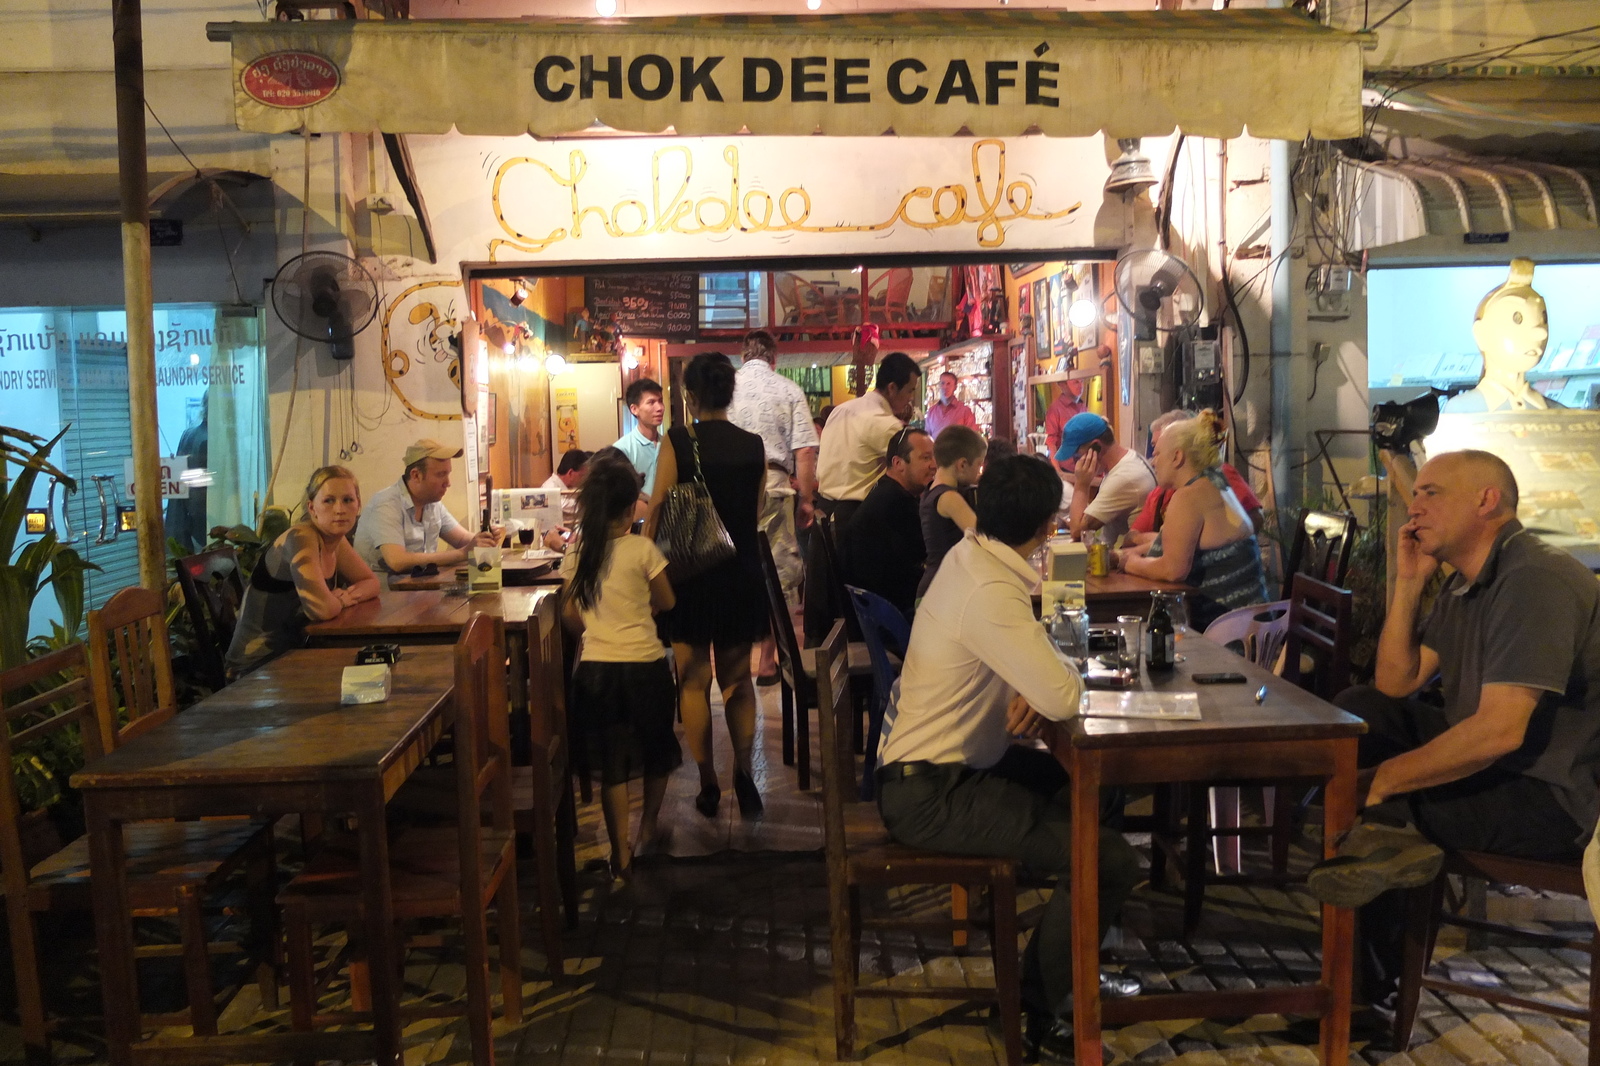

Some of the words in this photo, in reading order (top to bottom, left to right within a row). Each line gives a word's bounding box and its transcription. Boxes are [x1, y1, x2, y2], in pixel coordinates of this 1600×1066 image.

[534, 54, 724, 102] CHOK
[743, 56, 870, 103] DEE
[887, 41, 1059, 107] CAFÉ
[277, 89, 290, 97] 020
[155, 365, 200, 386] AUNDRY
[202, 364, 246, 385] SERVICE
